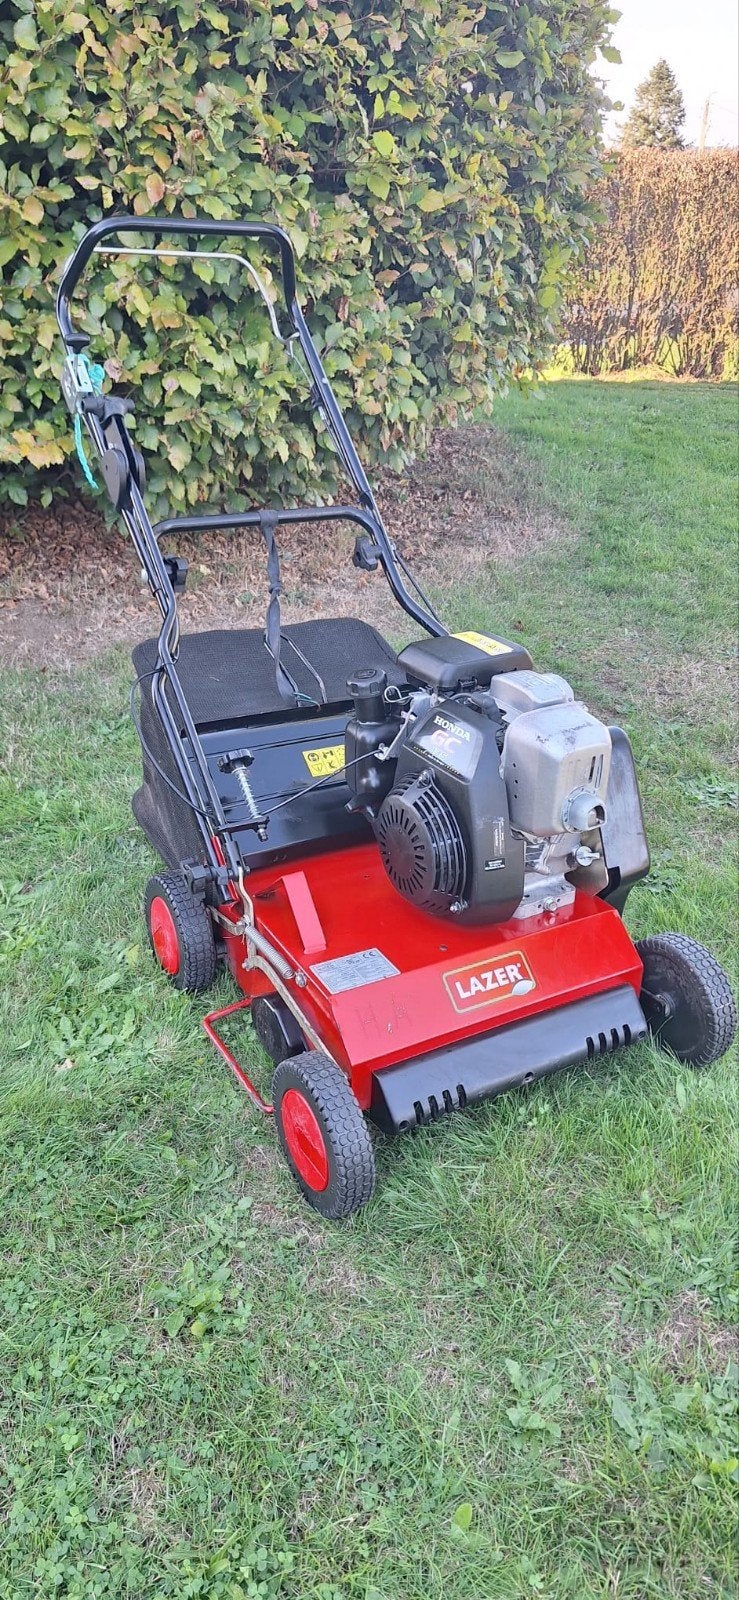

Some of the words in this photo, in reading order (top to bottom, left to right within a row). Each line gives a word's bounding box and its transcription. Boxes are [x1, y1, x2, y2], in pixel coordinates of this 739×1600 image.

[431, 729, 462, 754] GC
[433, 715, 470, 742] HONDA
[455, 964, 524, 999] LAZER
